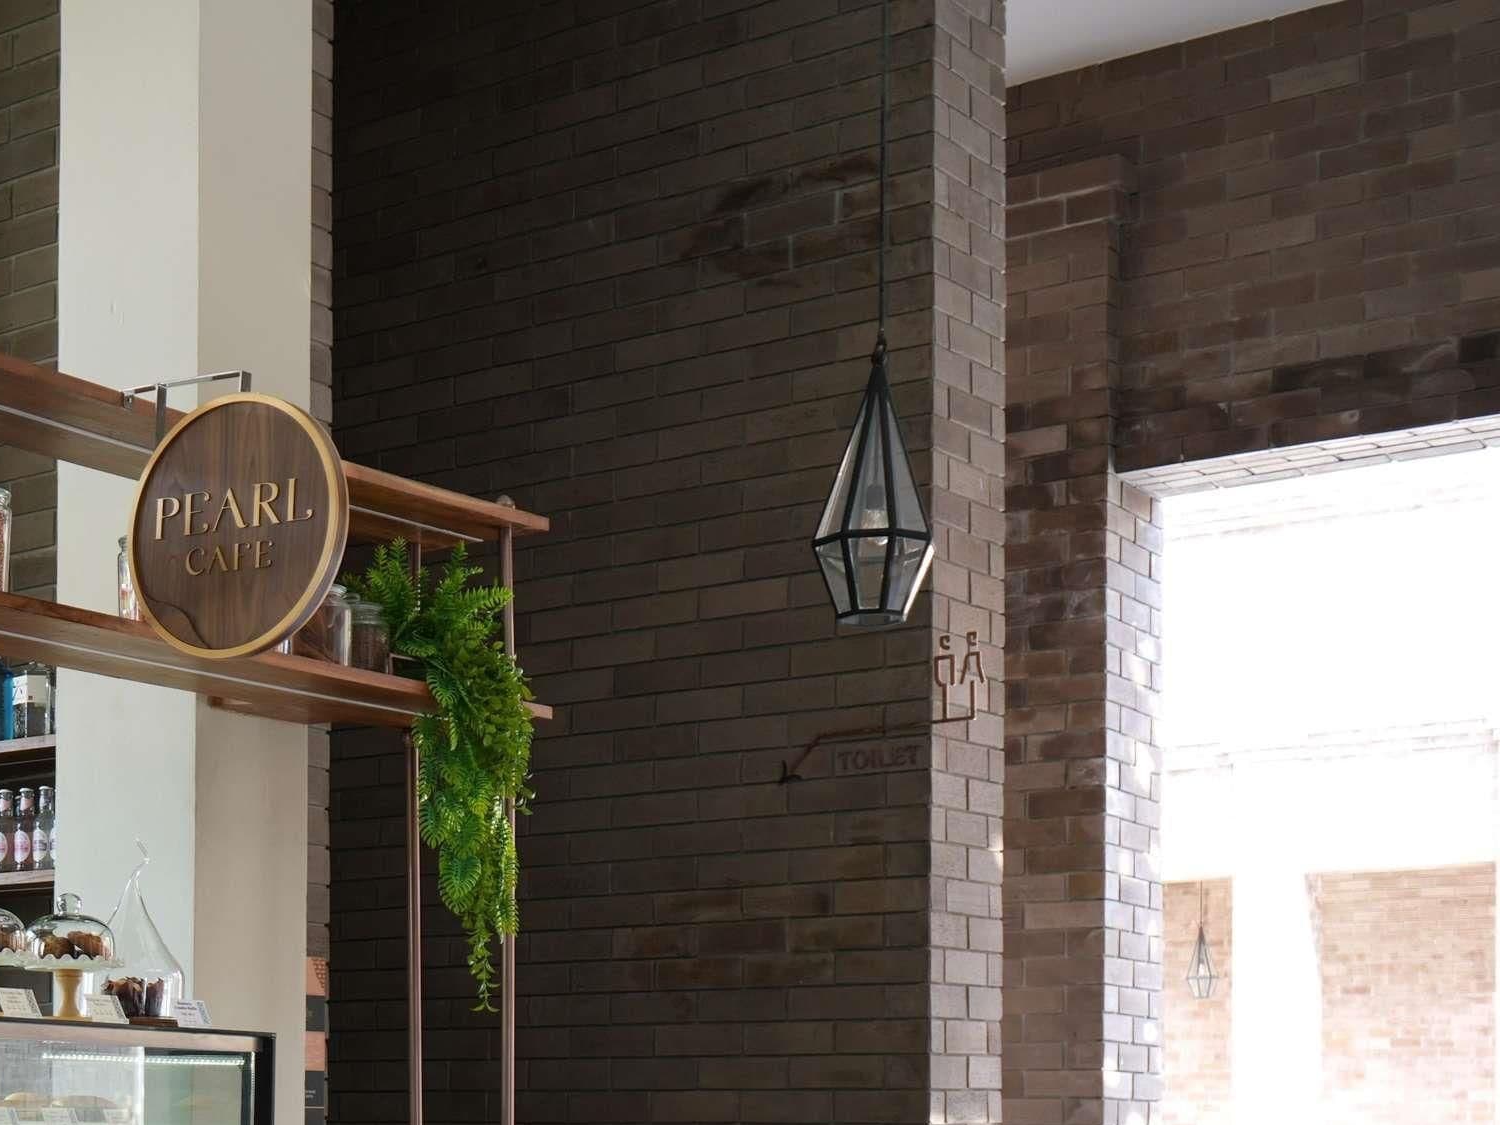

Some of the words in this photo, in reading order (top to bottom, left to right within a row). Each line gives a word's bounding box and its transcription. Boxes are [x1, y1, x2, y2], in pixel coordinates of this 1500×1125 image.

[154, 477, 315, 541] PEARL
[185, 540, 274, 577] CAFE
[837, 745, 923, 770] TOILET
